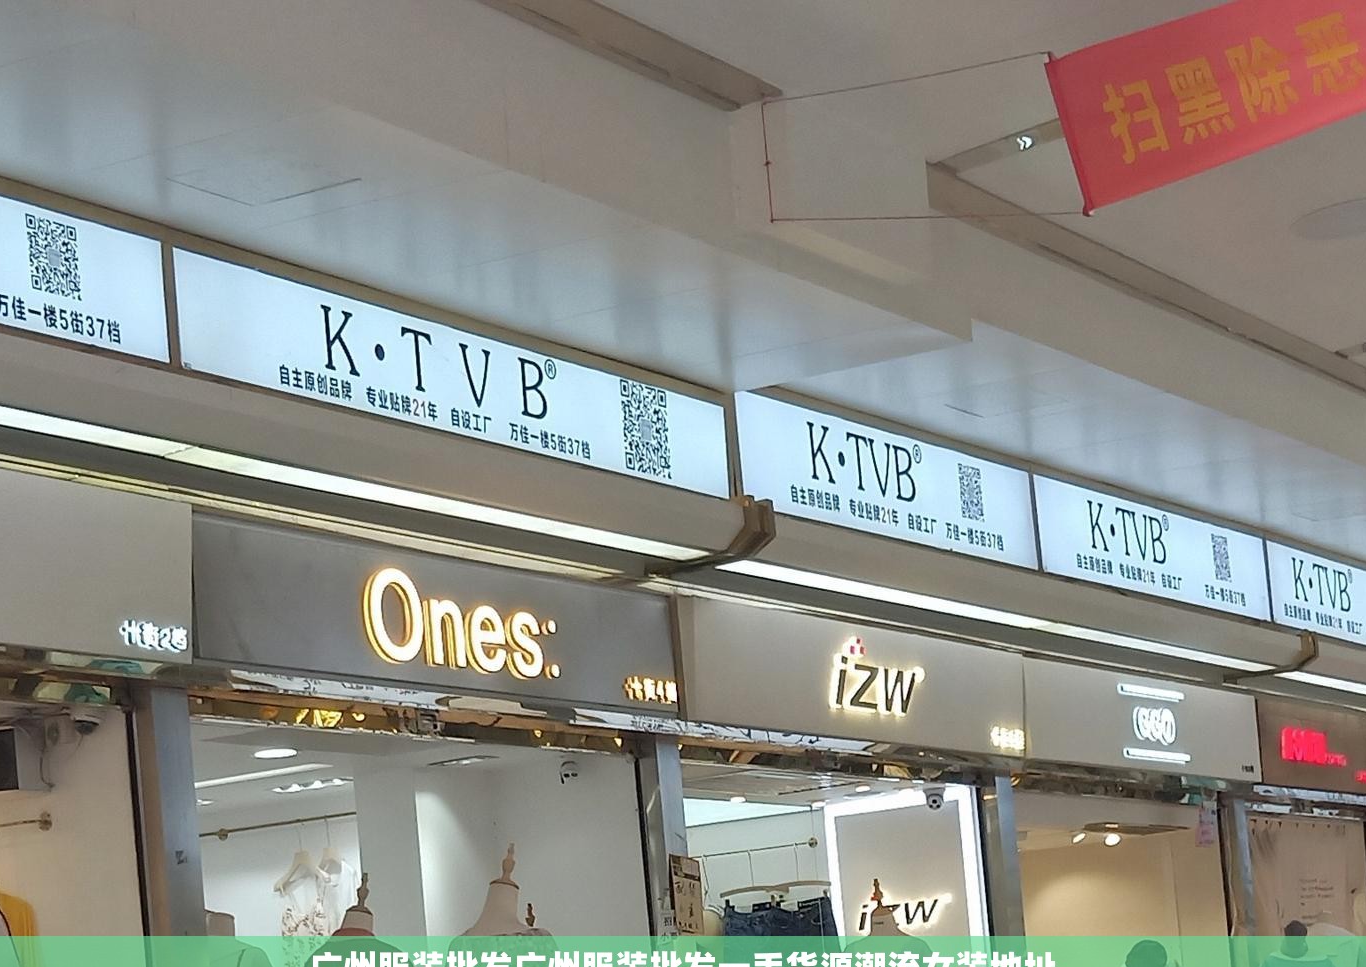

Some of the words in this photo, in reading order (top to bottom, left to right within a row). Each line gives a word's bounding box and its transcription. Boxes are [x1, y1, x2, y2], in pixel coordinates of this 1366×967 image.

[279, 364, 353, 402] 自主原创品牌
[366, 387, 438, 421] 专业贴牌21年
[451, 407, 492, 433] 自设工厂
[509, 422, 591, 460] 万佳一楼5街37档
[790, 485, 840, 514] 自主原创品牌
[908, 513, 937, 534] 自设工厂
